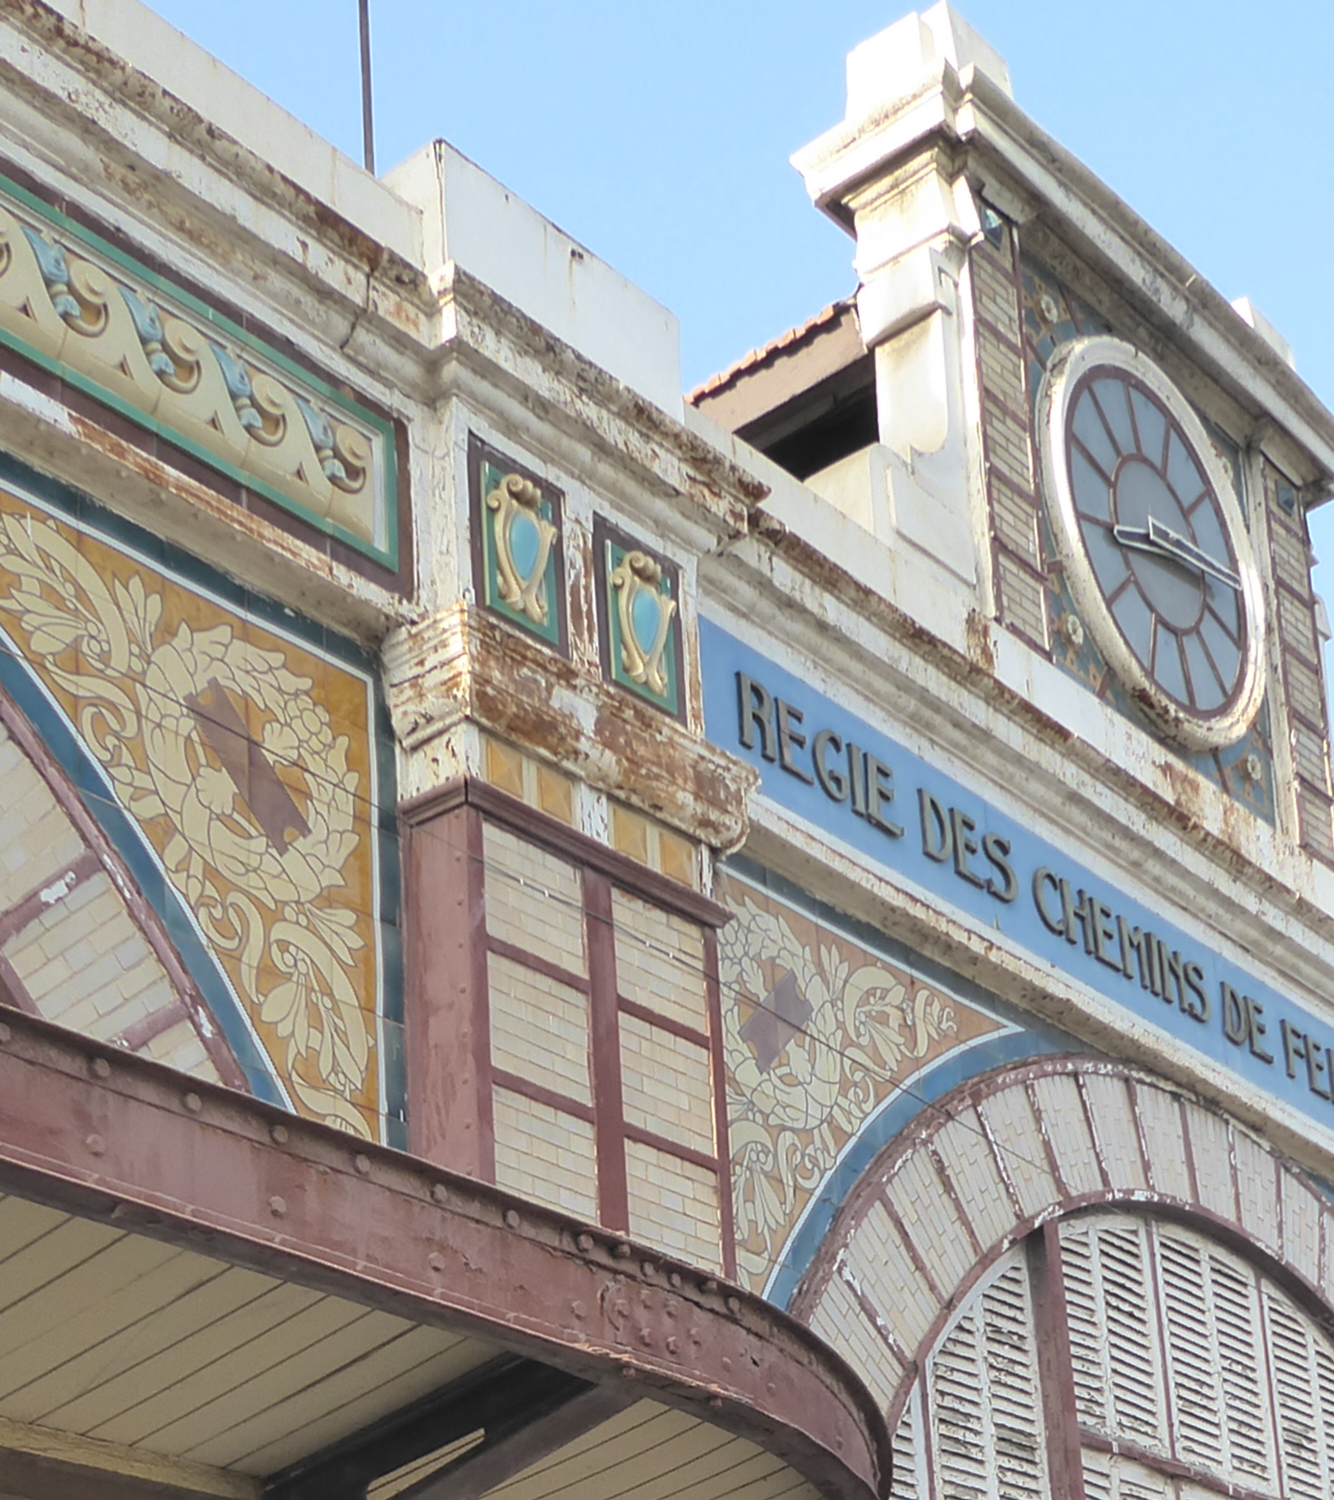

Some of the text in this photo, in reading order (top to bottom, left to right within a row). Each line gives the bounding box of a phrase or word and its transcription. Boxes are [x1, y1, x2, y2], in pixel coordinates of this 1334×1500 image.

[736, 671, 904, 837] REGIE
[917, 788, 1019, 902] DES
[1032, 867, 1212, 1023] CHEMINS
[1220, 981, 1274, 1065] DE
